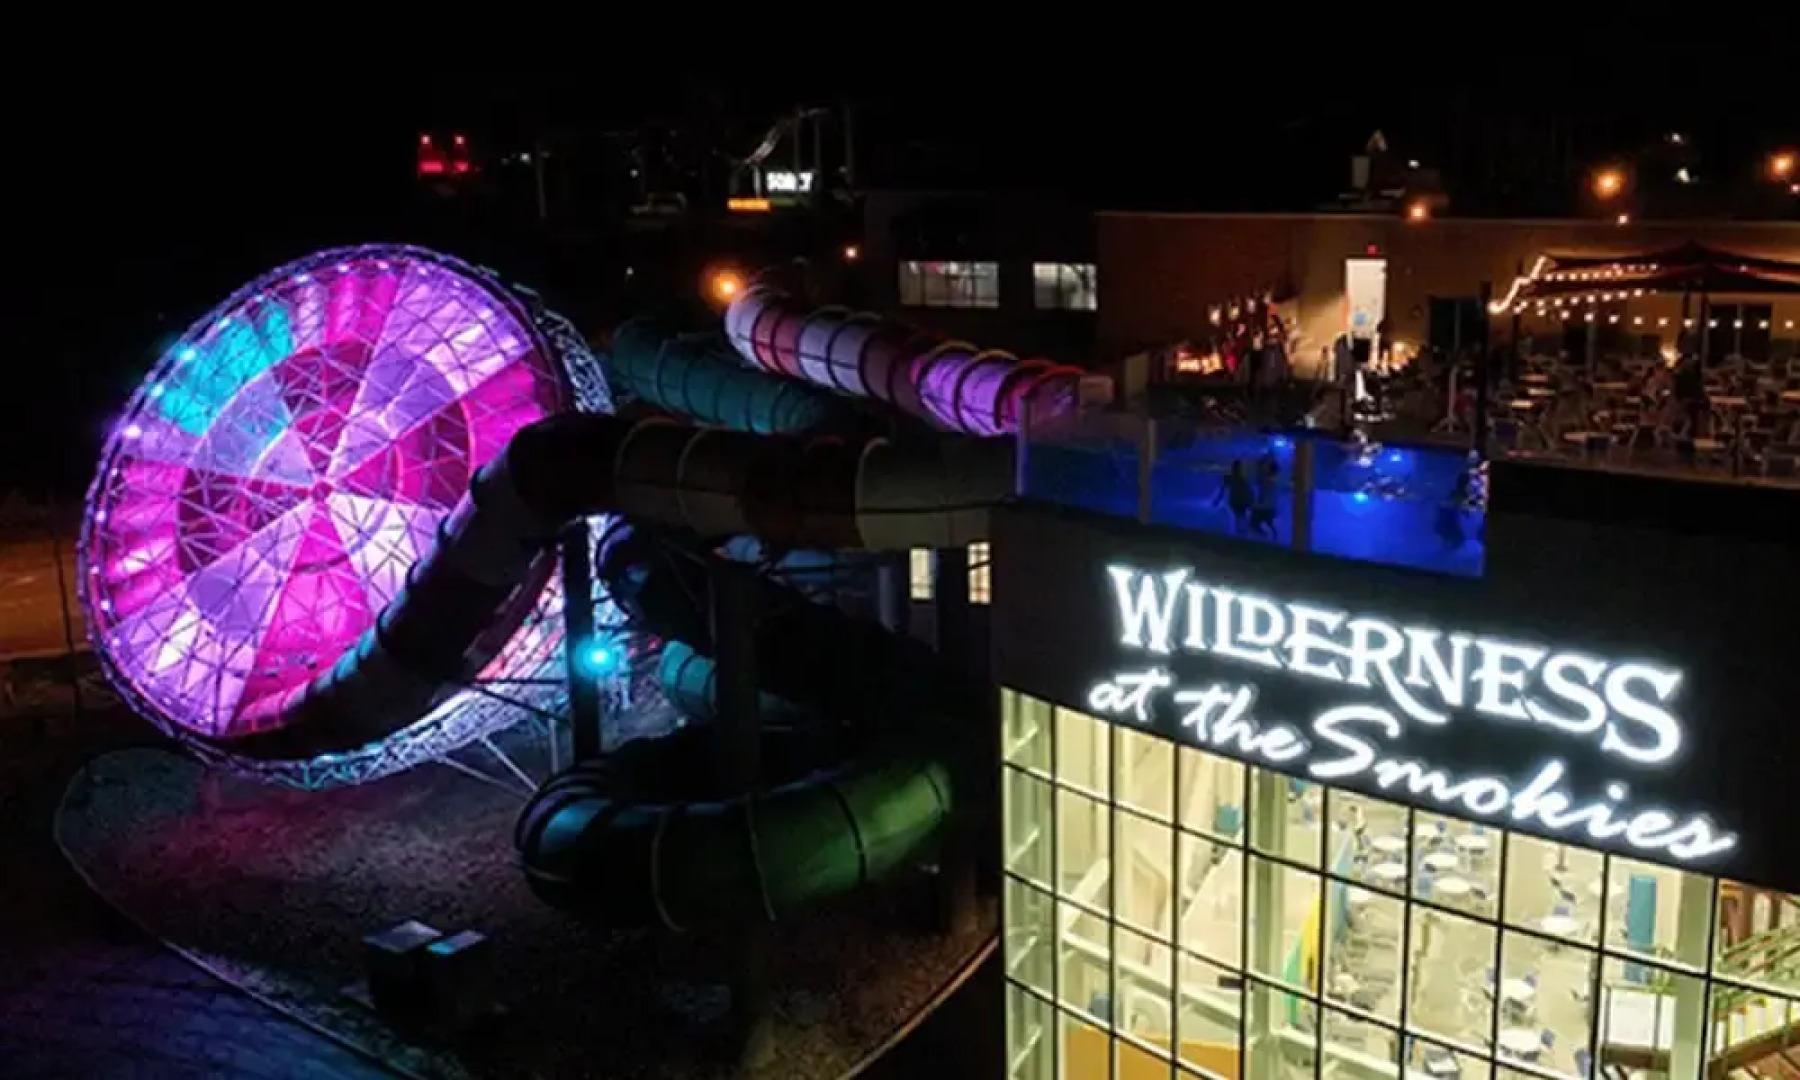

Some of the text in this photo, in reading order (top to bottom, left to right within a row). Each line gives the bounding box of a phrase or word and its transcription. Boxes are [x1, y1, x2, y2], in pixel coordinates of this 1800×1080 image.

[1087, 666, 1738, 859] at the Smokies
[1106, 563, 1684, 765] WILDERNESS
